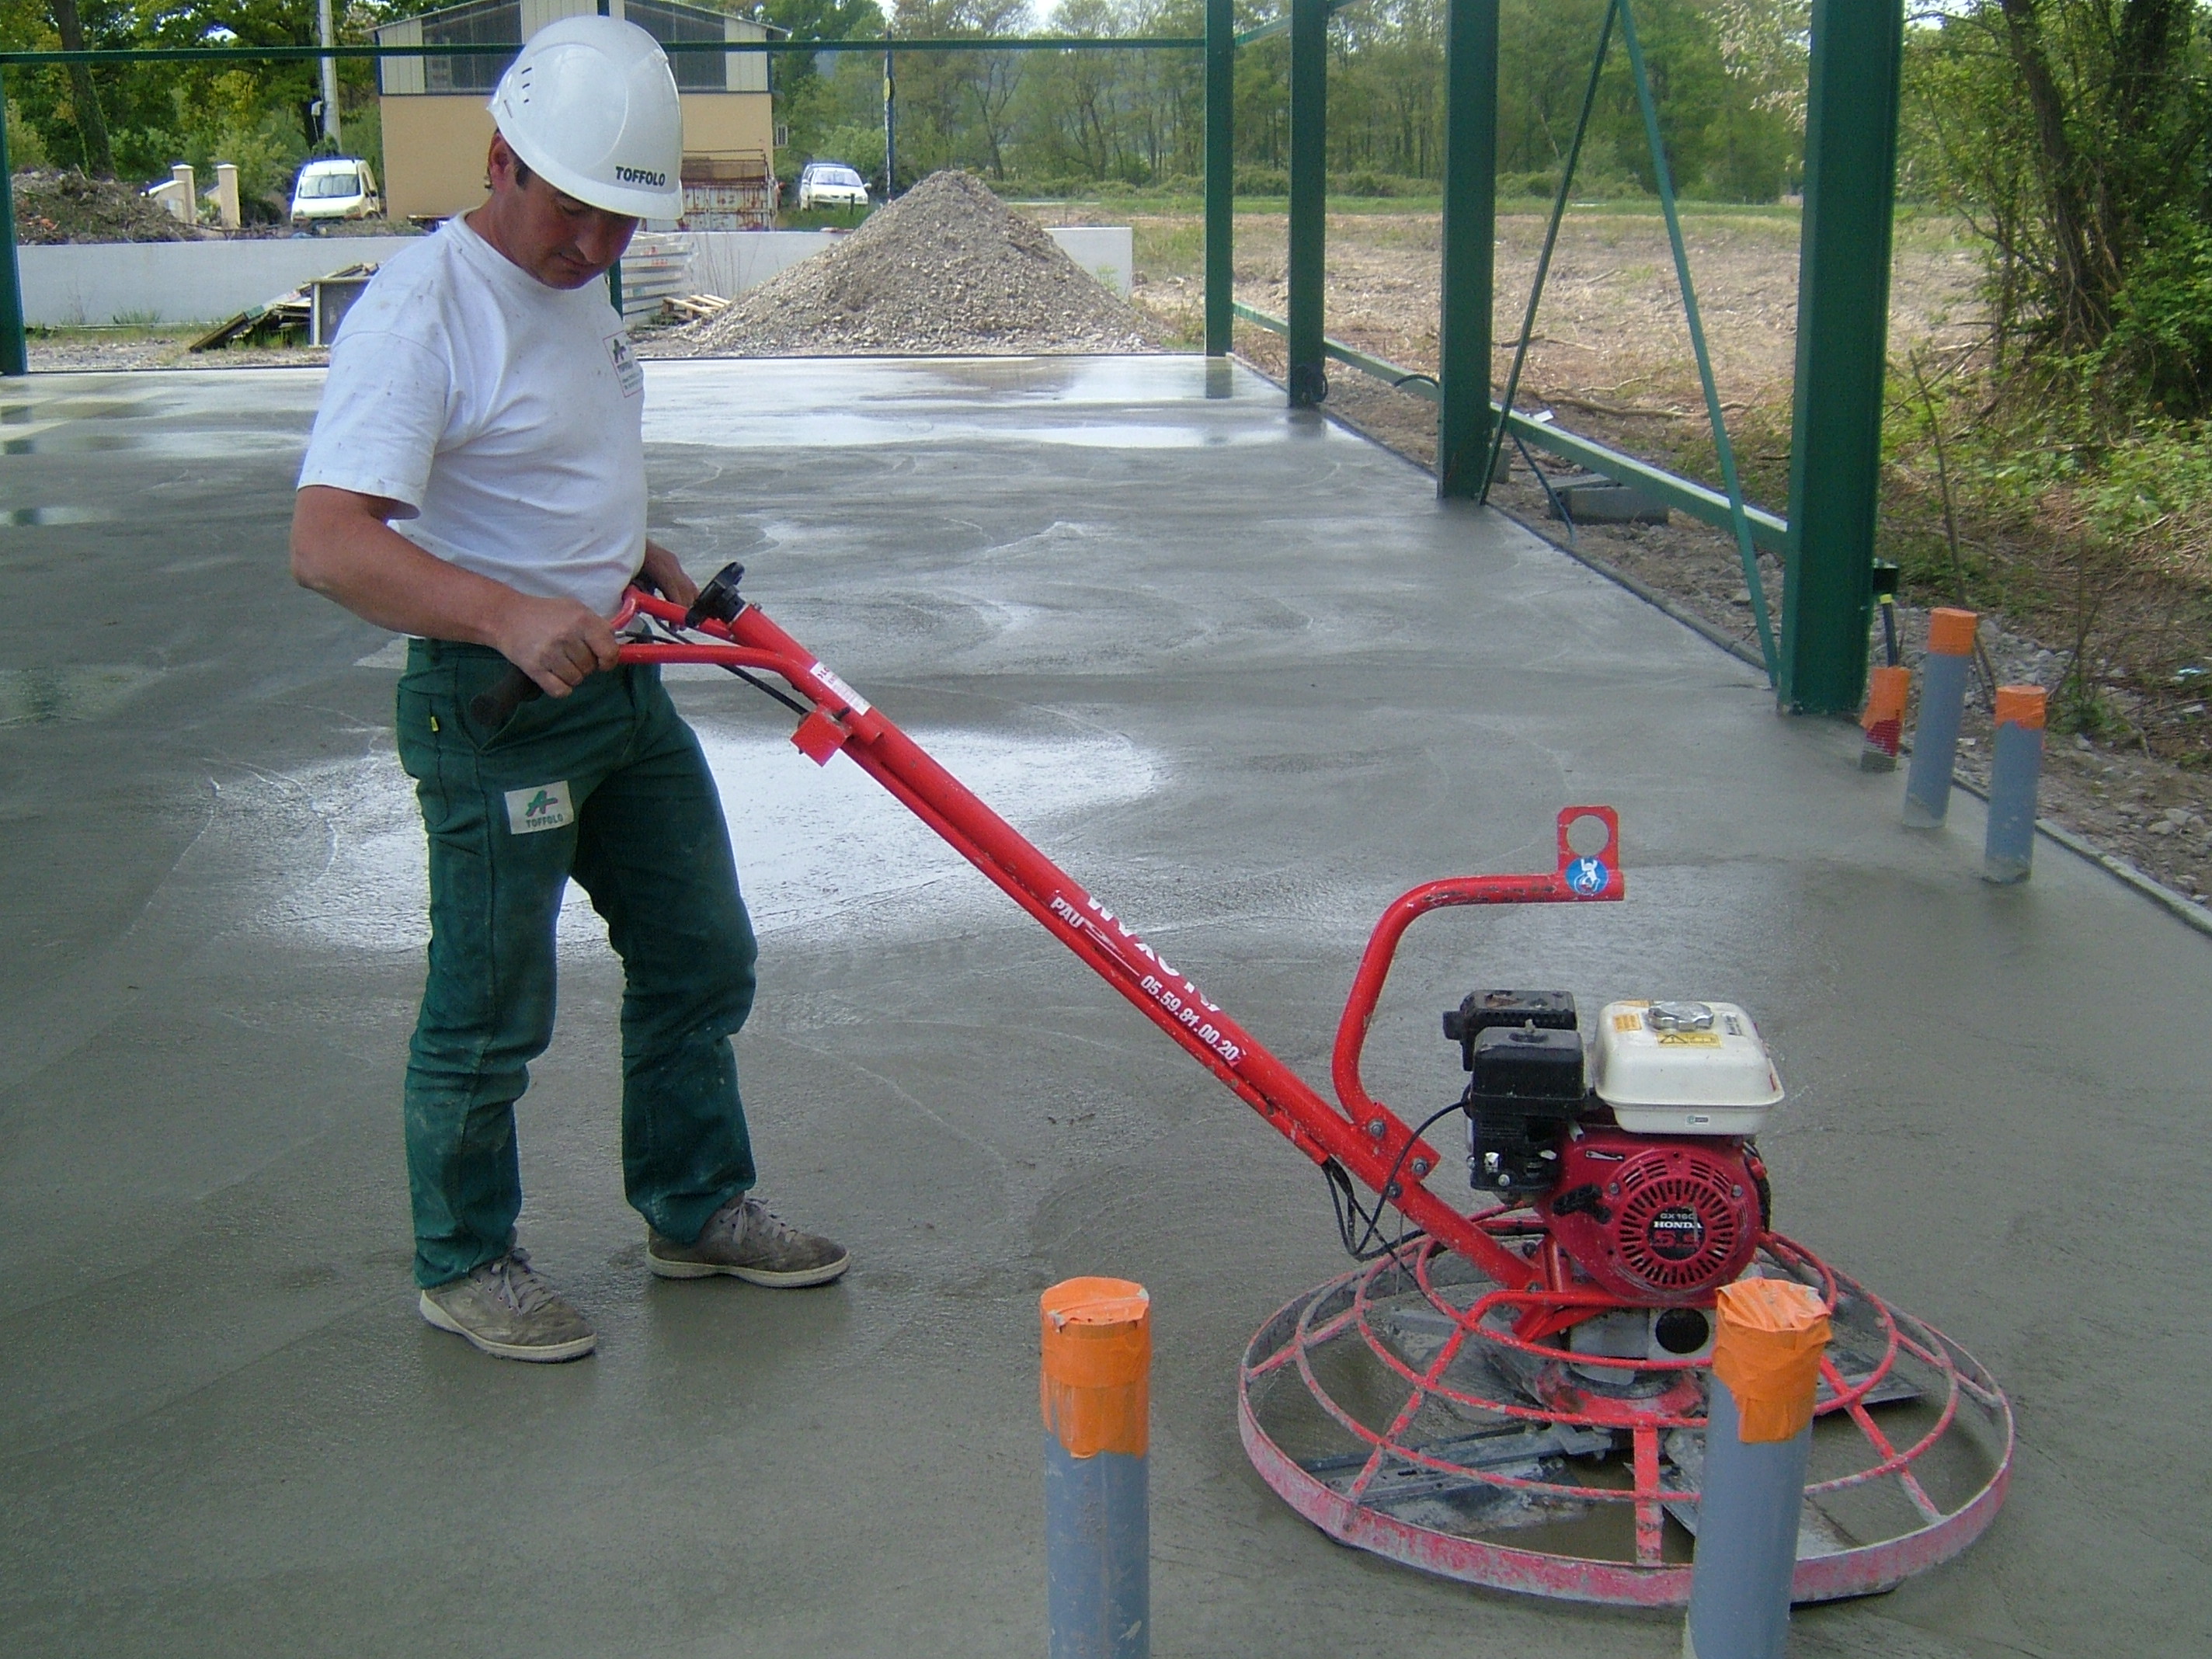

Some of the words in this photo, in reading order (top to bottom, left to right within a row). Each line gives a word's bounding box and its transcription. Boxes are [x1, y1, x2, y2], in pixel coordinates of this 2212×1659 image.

[615, 165, 666, 186] TOFFOLO
[526, 813, 564, 828] TOFFOLO
[1050, 896, 1084, 929] PAU
[1140, 975, 1240, 1062] 05.59.81.00.20
